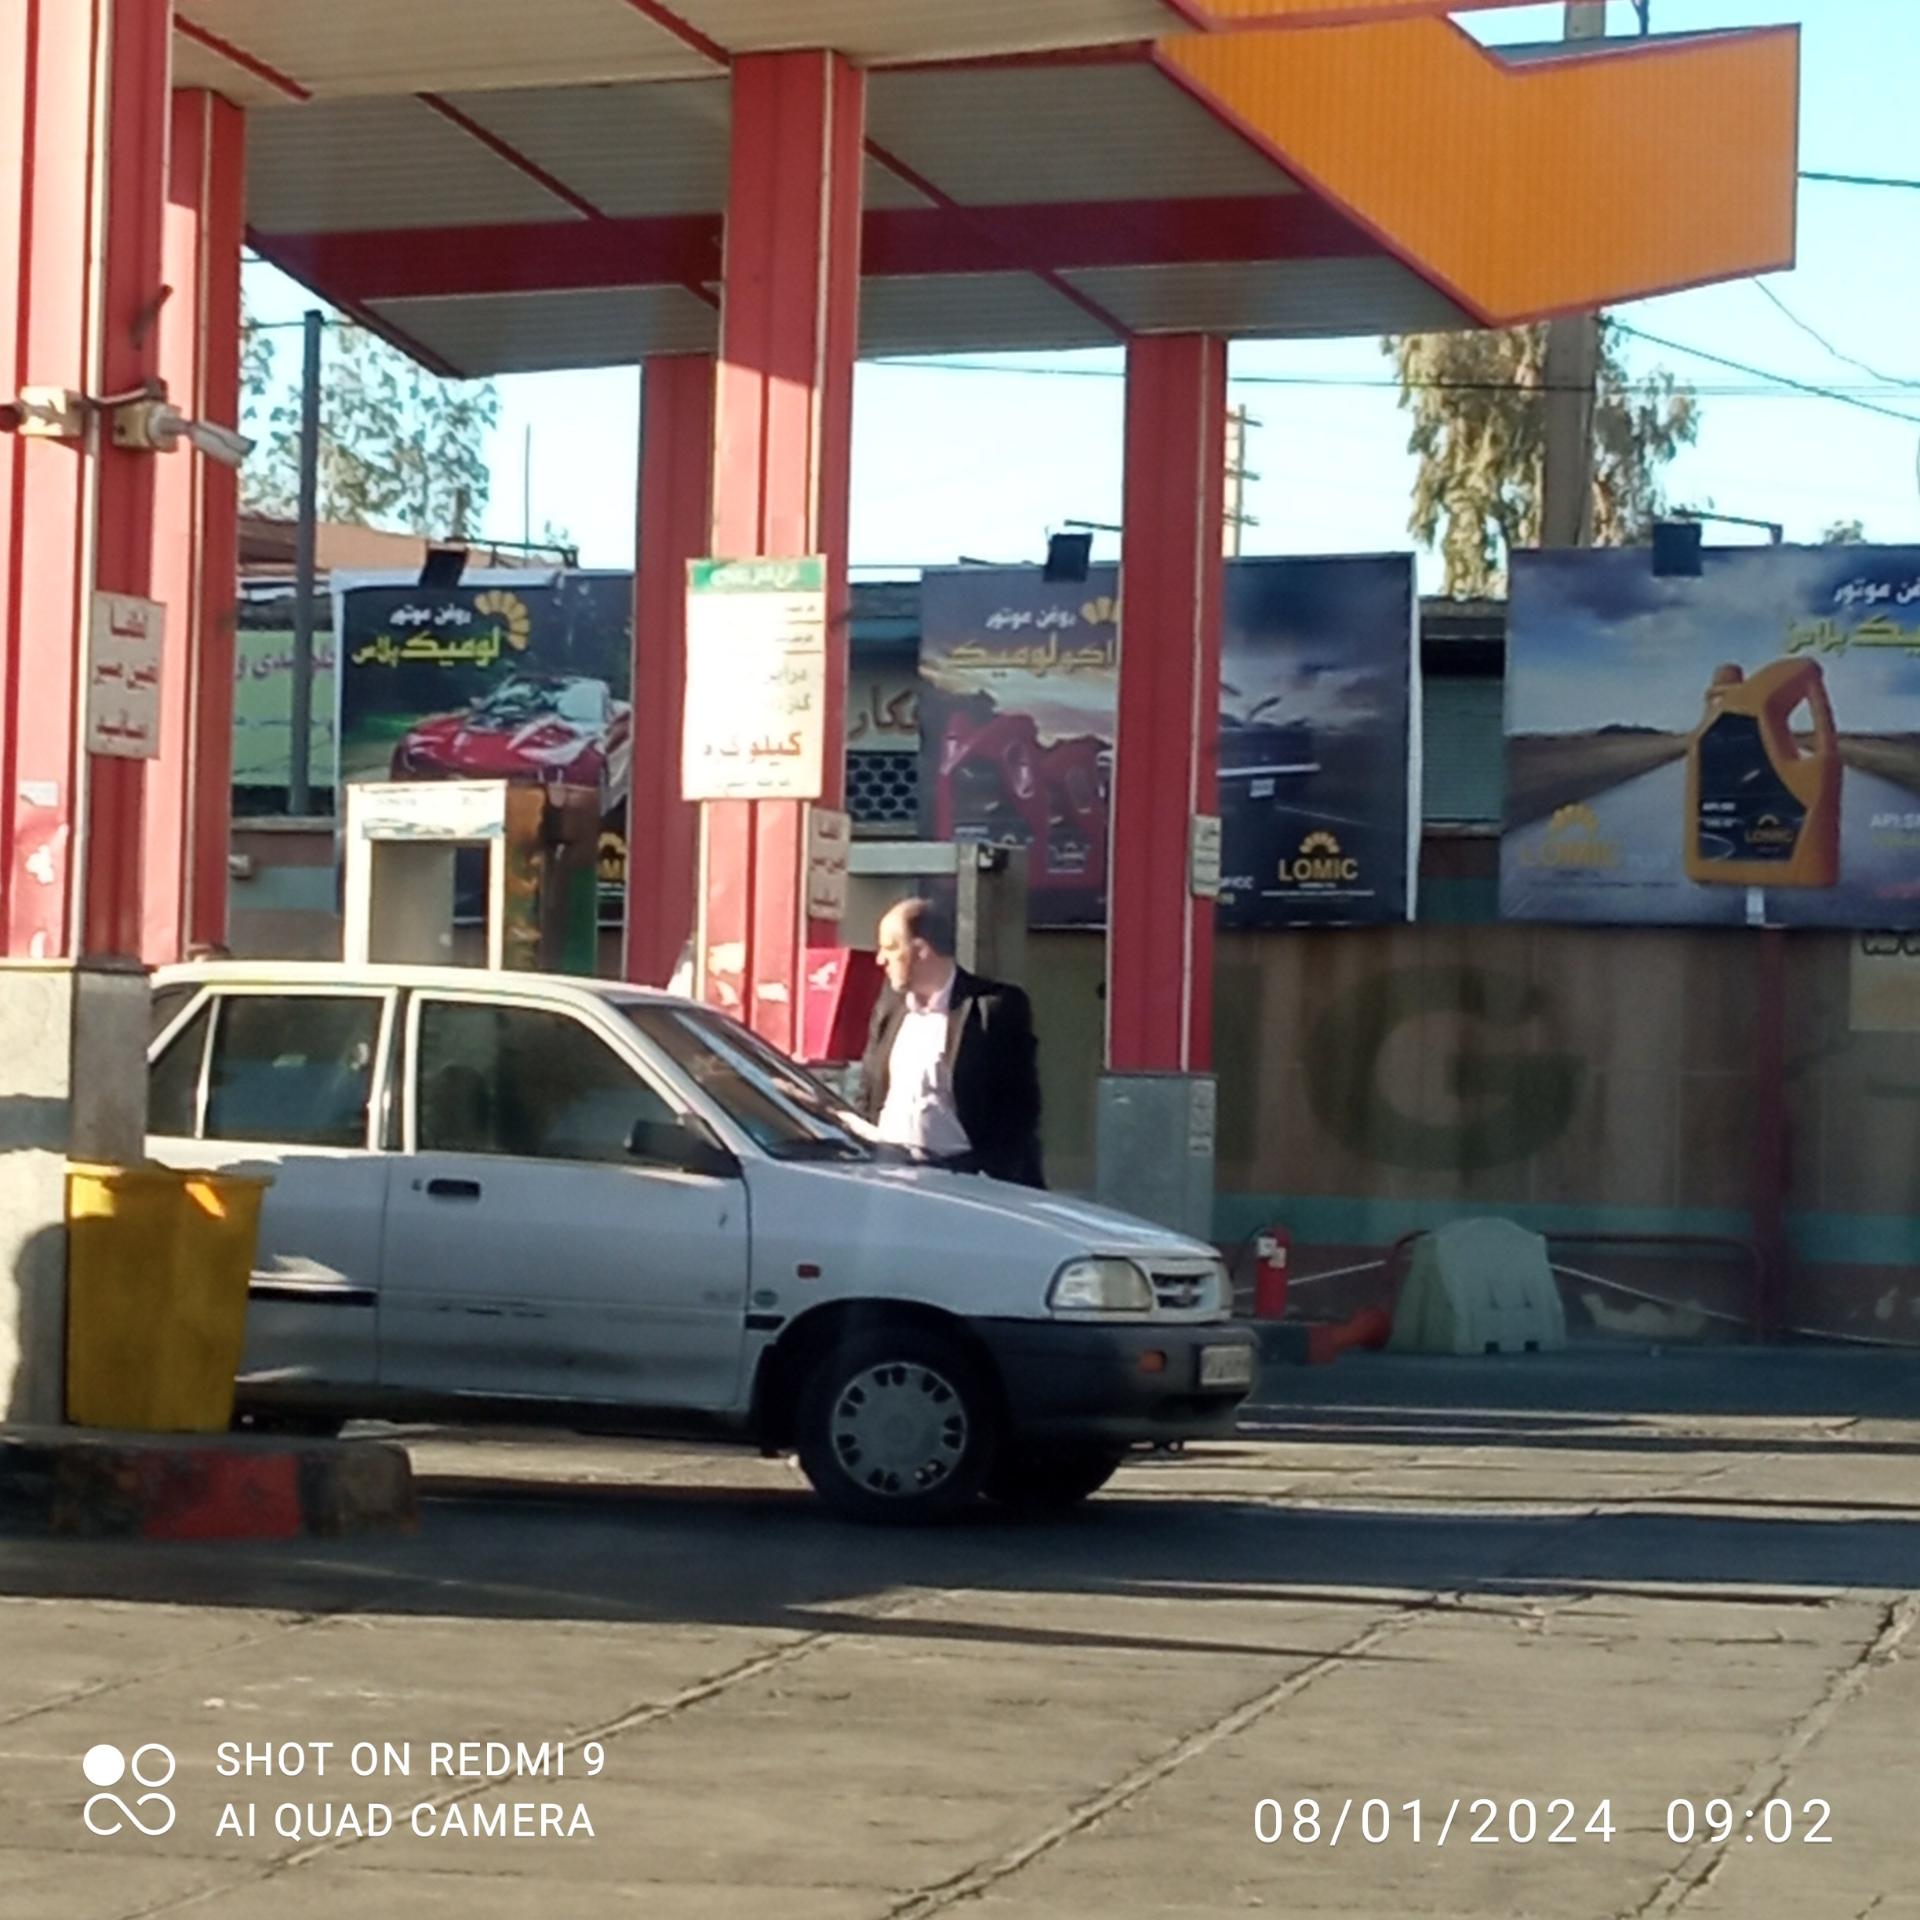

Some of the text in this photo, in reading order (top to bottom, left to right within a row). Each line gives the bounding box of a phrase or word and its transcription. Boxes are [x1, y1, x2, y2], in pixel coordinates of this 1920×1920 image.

[1834, 578, 1890, 608] موتور
[389, 604, 472, 626] روغن موتور
[985, 606, 1077, 630] روغن موتور
[400, 625, 500, 667] لومیک
[1278, 857, 1358, 882] LOMIC
